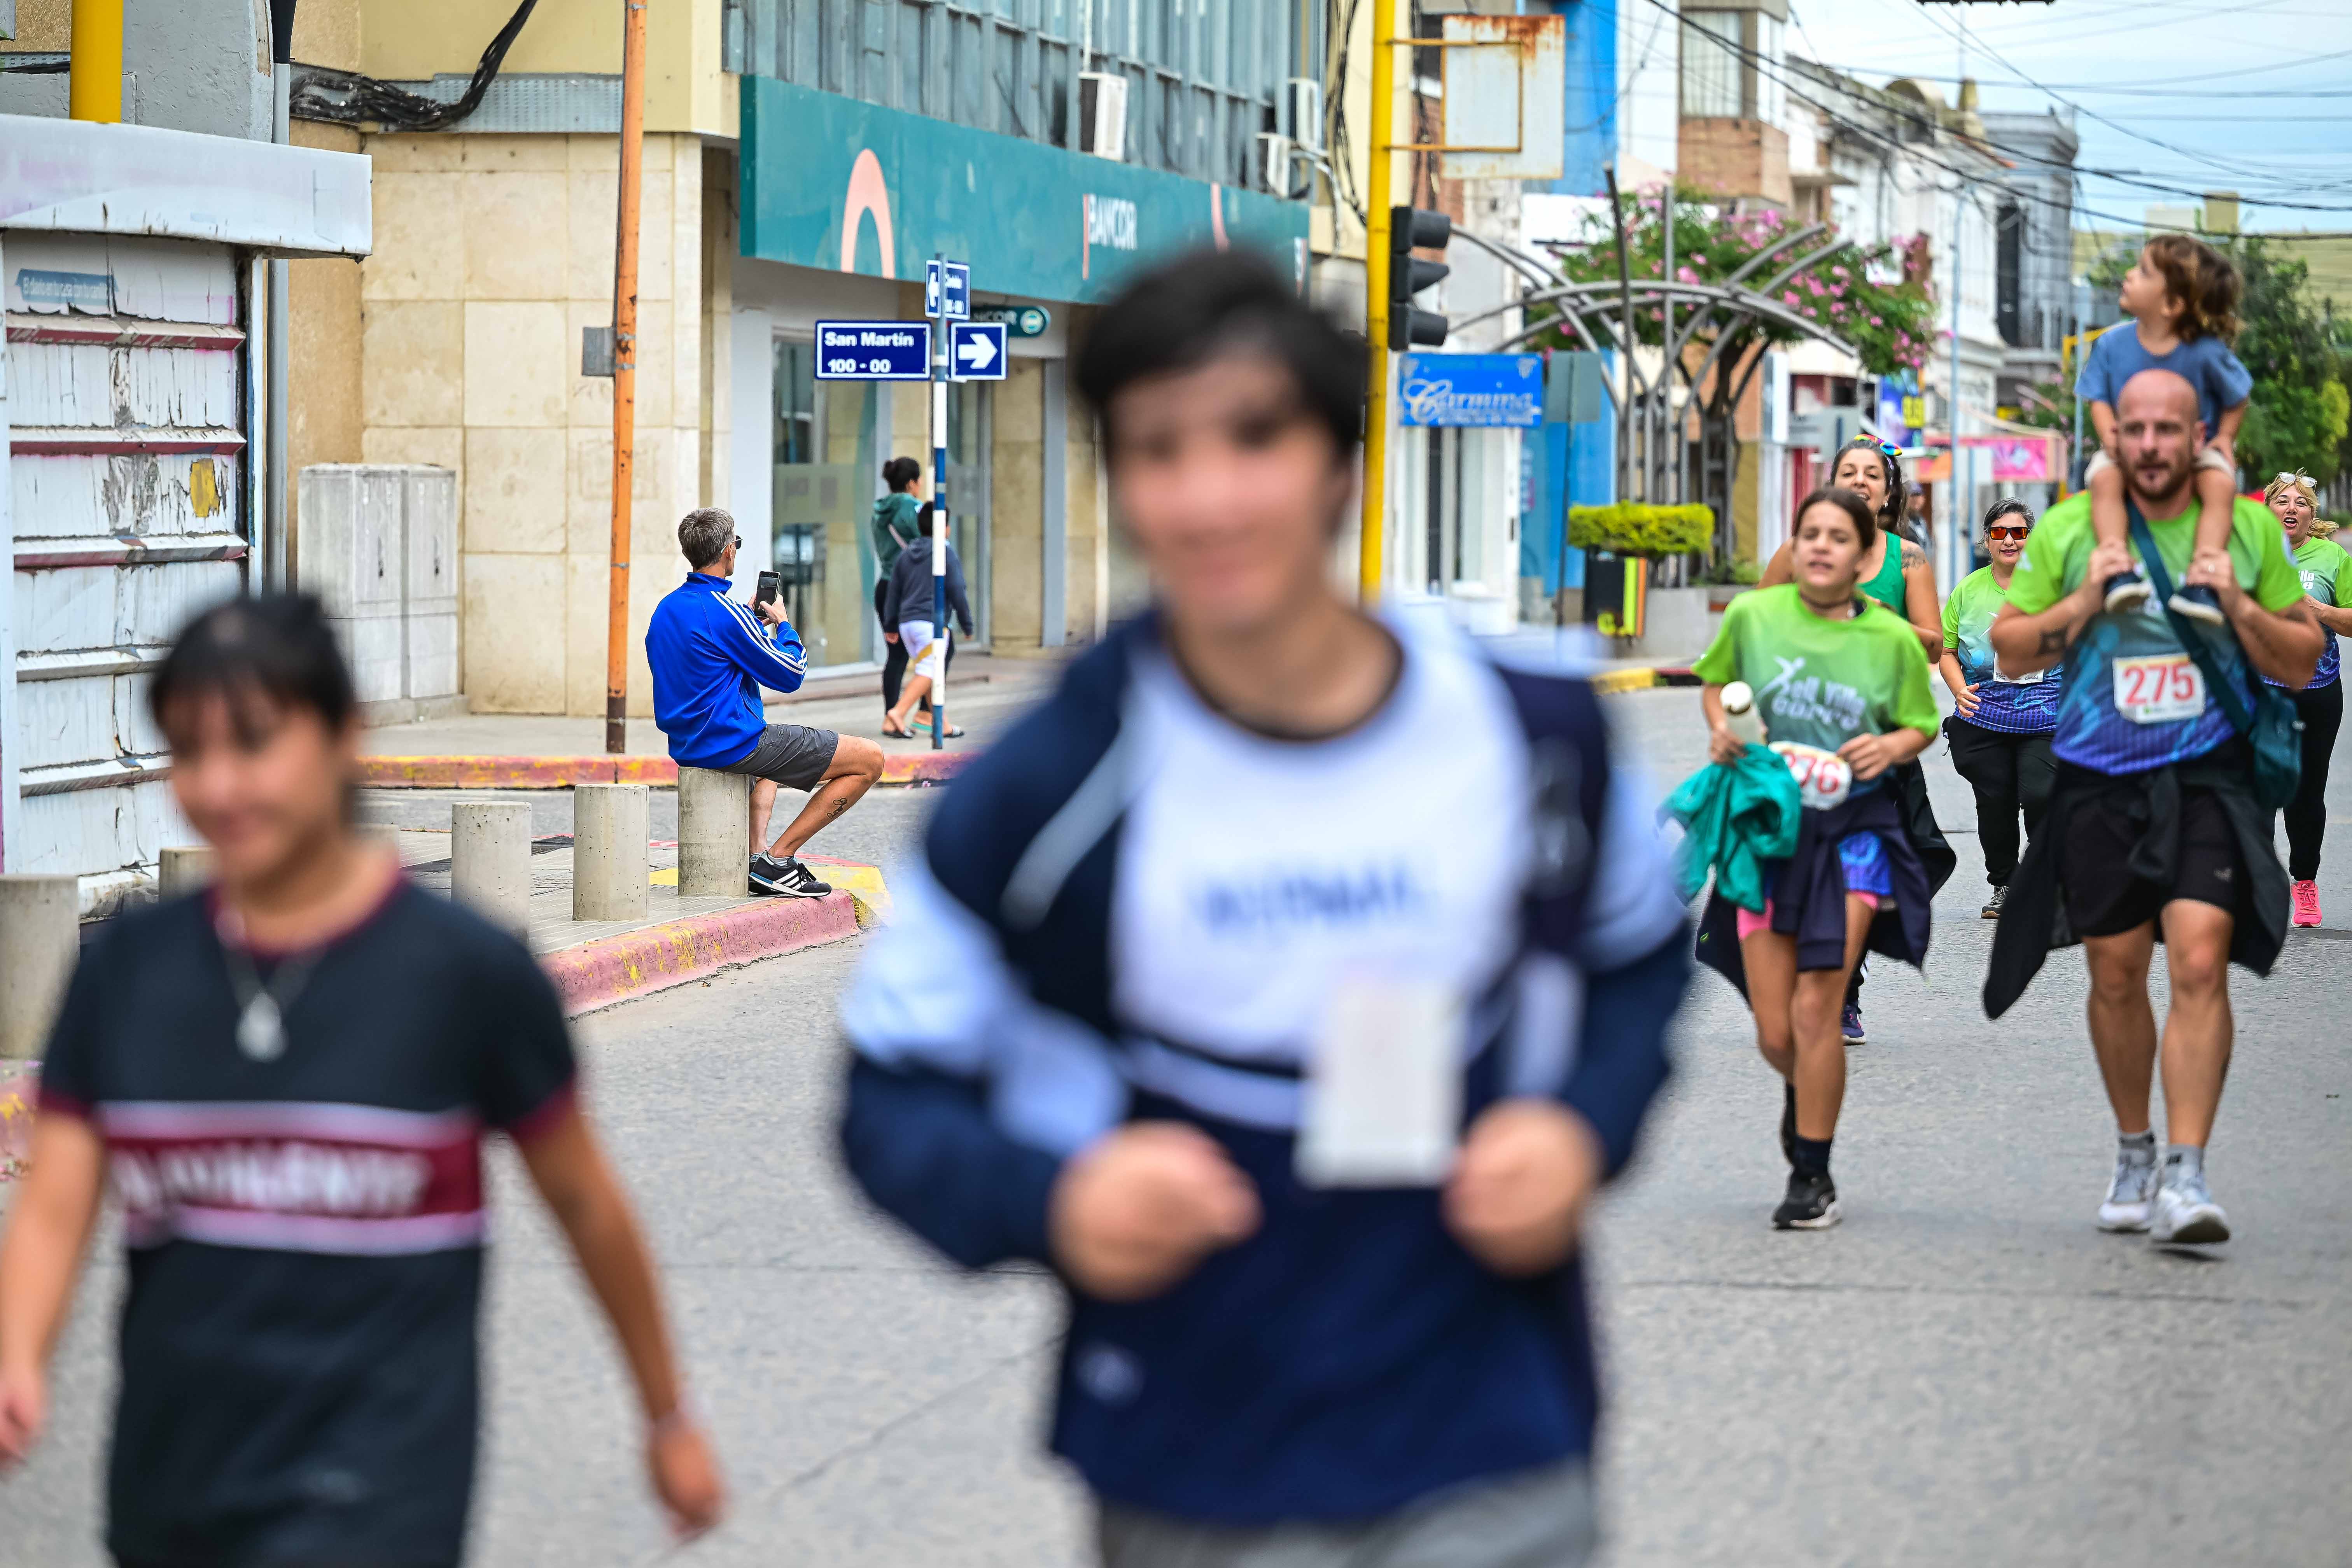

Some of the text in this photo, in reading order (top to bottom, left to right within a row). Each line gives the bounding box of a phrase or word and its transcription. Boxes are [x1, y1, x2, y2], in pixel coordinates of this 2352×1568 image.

[824, 331, 857, 346] San
[828, 358, 857, 373] 100
[869, 359, 891, 373] 00
[2123, 662, 2194, 706] 275
